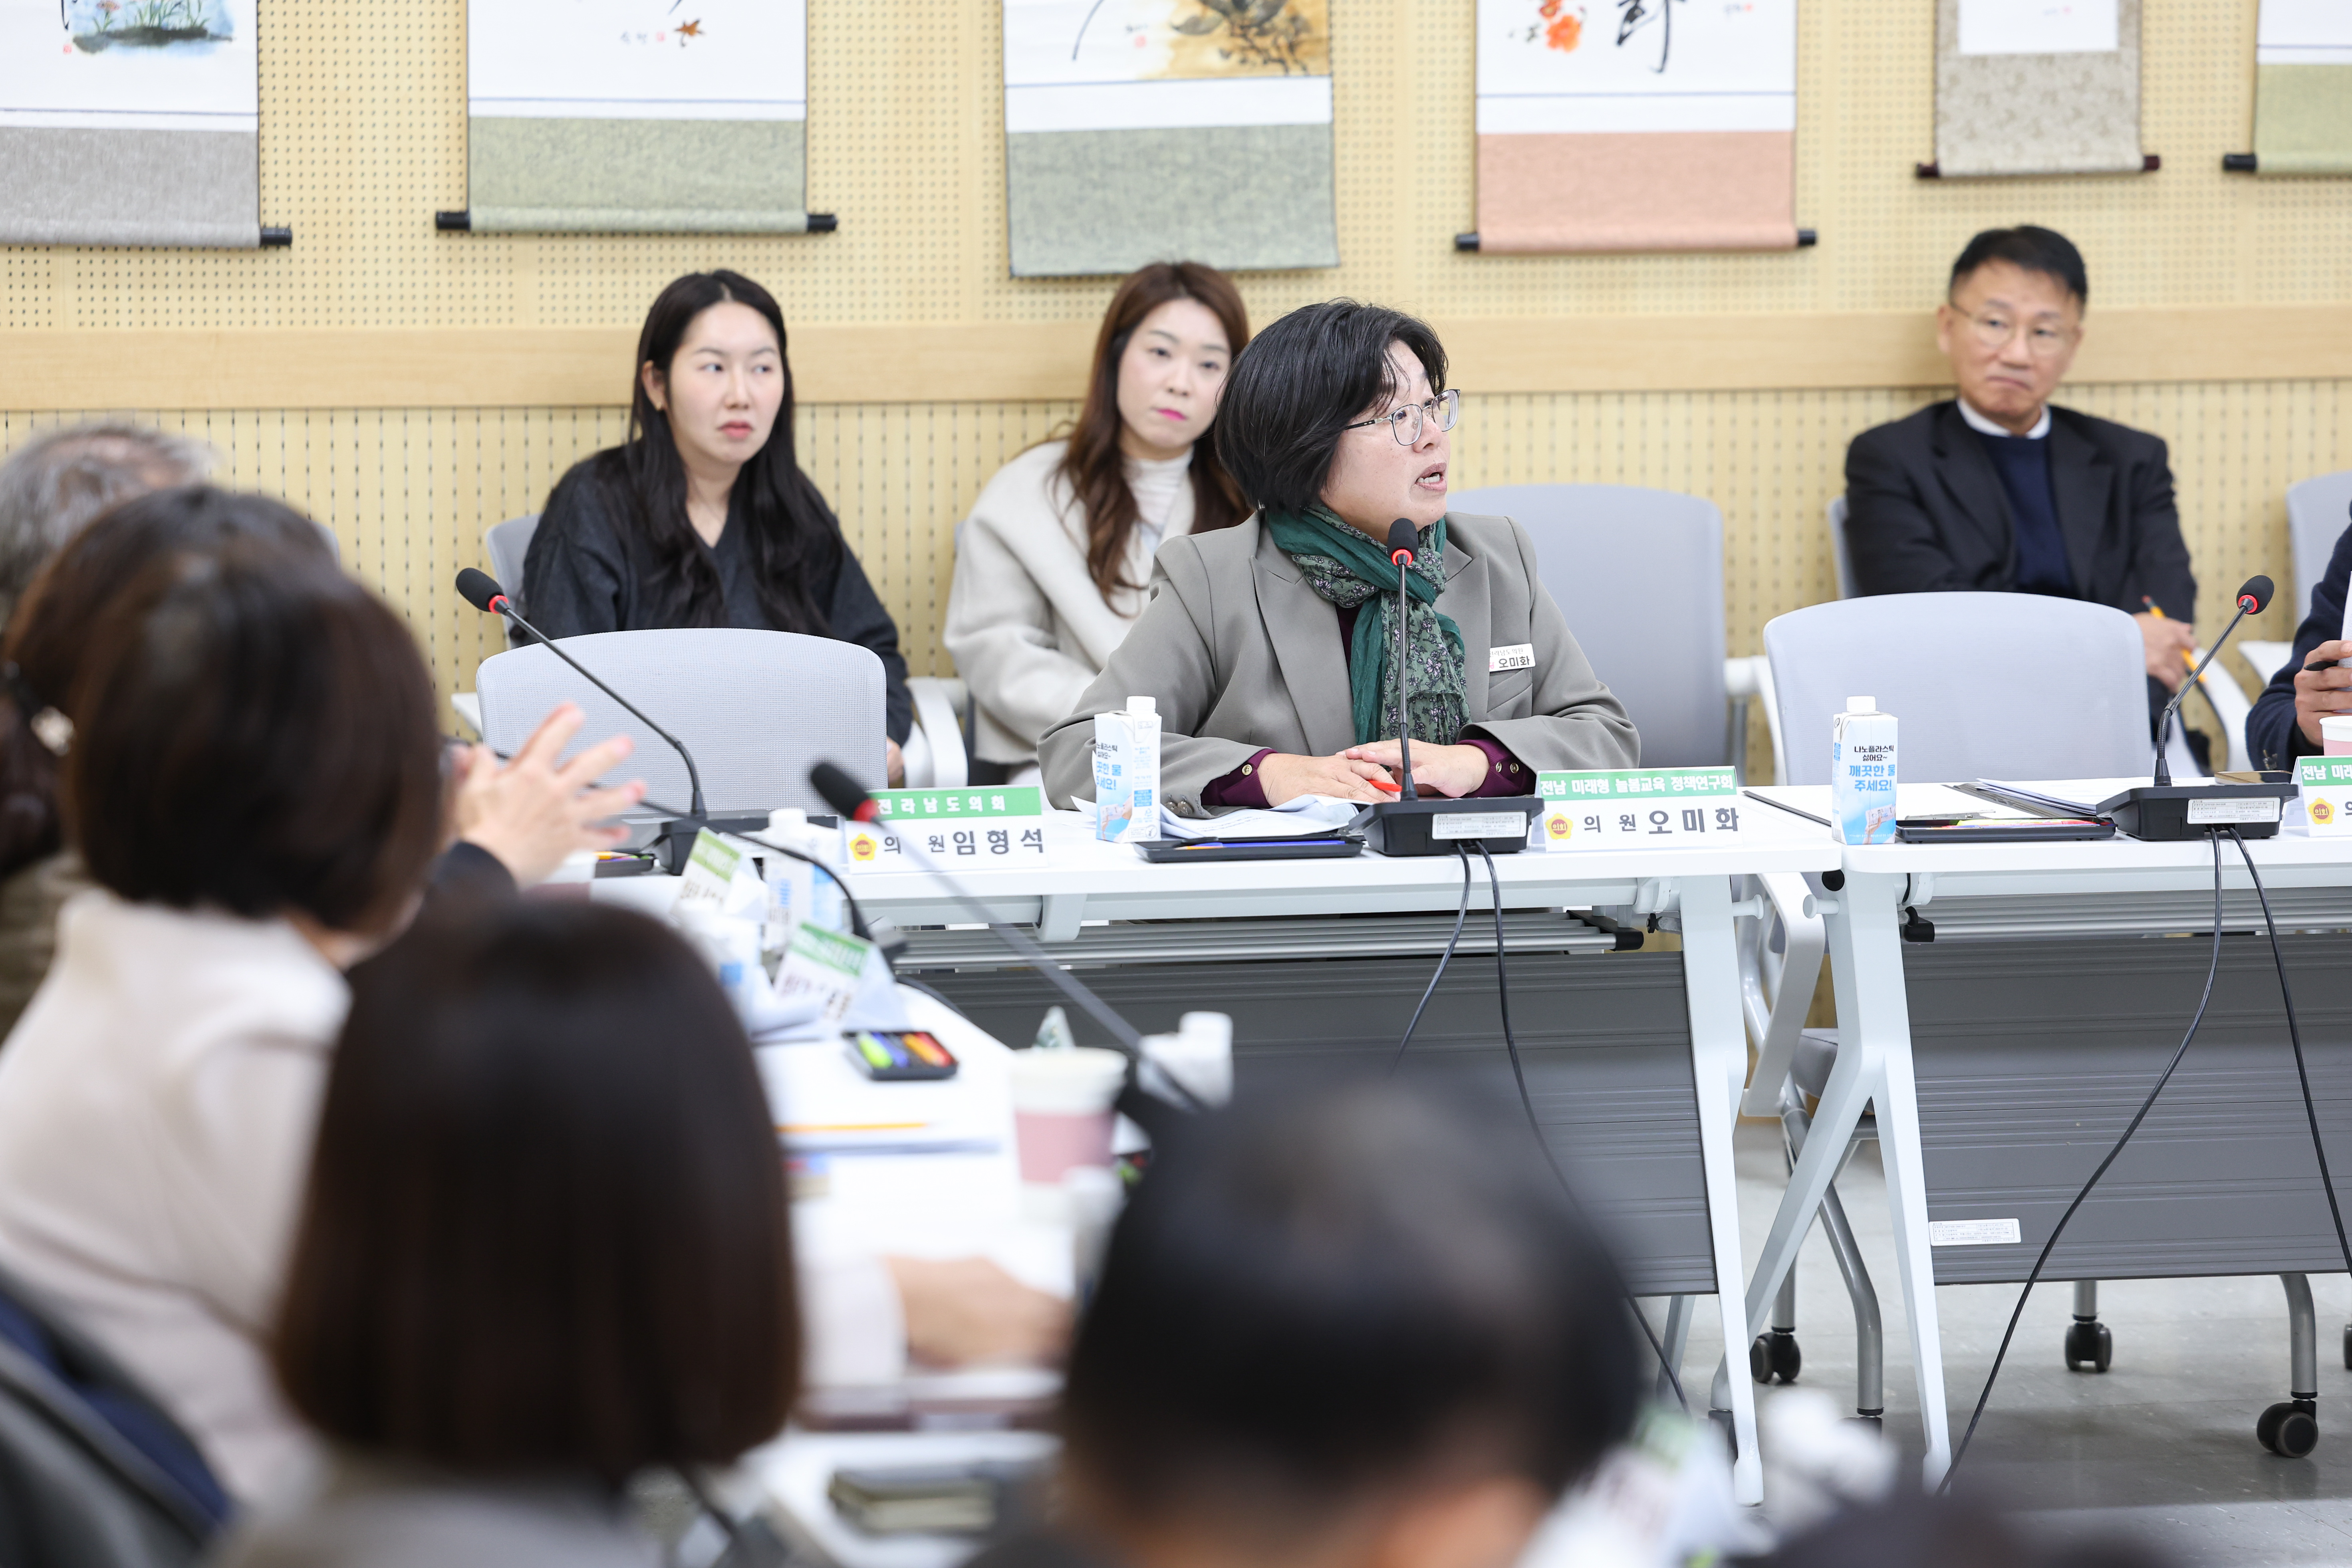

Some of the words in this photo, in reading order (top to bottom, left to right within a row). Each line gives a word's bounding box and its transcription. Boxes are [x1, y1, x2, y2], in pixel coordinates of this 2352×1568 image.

[1499, 655, 1530, 668] 오미화
[1112, 764, 1121, 776] 물
[1849, 765, 1884, 776] 깨끗한
[1888, 764, 1895, 776] 물
[2301, 765, 2326, 780] 전남
[1540, 780, 1566, 795] 전남
[1572, 779, 1610, 795] 미래형
[1616, 777, 1665, 793] 늘봄교육
[1671, 774, 1733, 791] 정책연구회
[1854, 780, 1892, 791] 주세요!
[1552, 823, 1567, 832] 의회
[1648, 808, 1739, 834] 오미화
[953, 828, 1044, 855] 임형석
